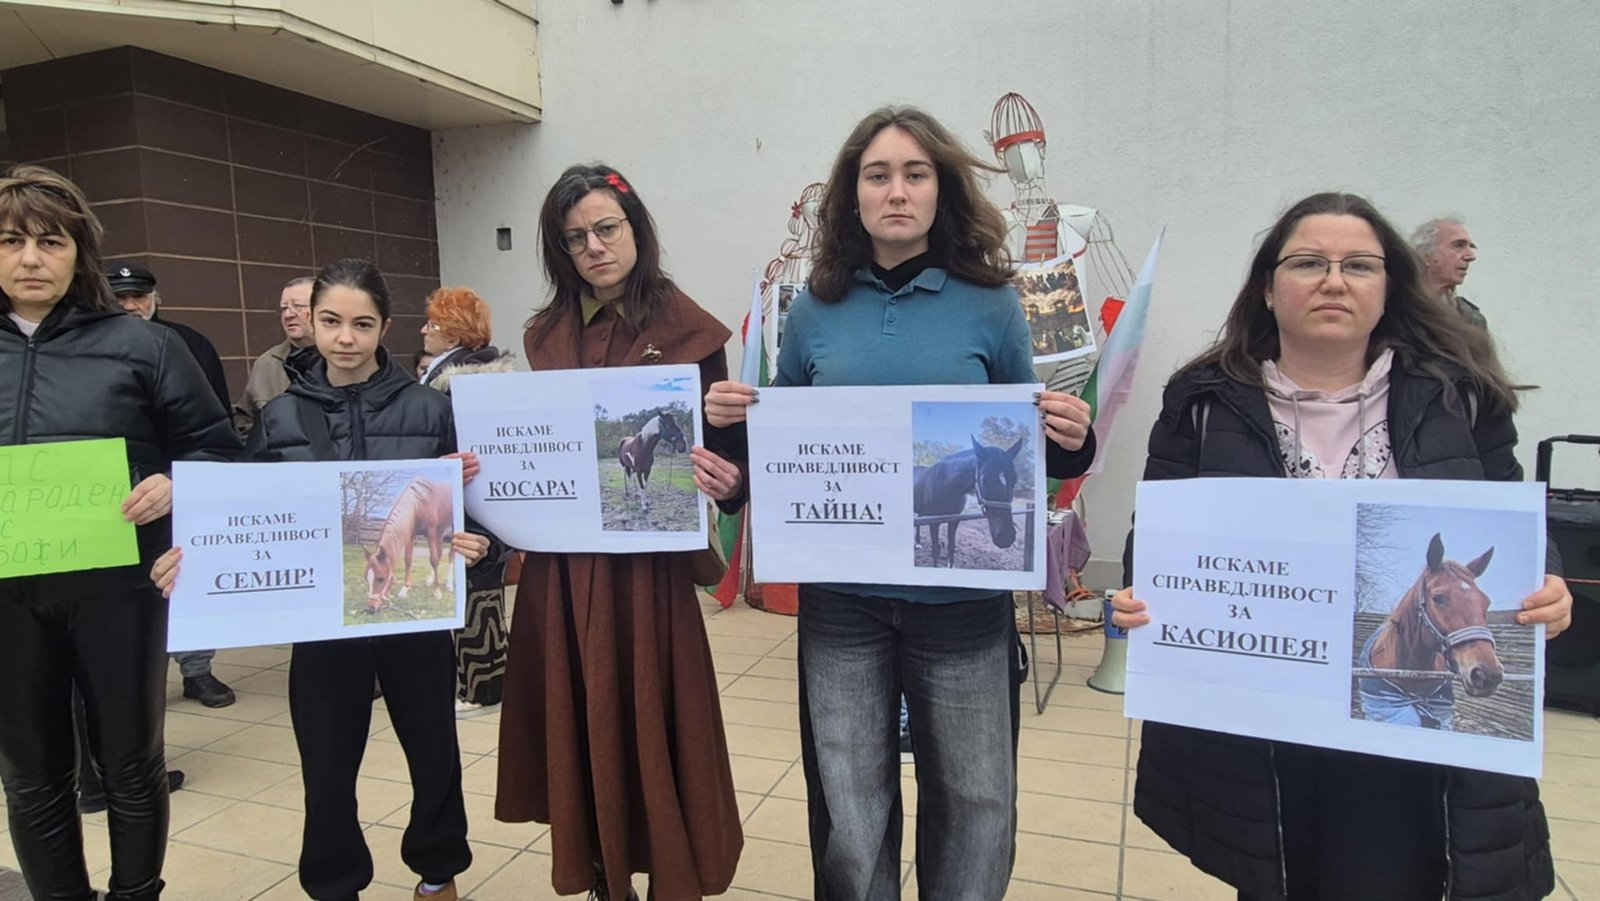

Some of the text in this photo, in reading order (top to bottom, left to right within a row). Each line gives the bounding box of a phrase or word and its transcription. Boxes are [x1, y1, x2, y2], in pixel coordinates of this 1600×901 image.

[496, 424, 555, 438] ИСКАМЕ
[470, 441, 583, 455] СПРАВЕДЛИВОСТ
[798, 443, 865, 456] ИСКАМЕ
[520, 459, 535, 471] ЗА
[765, 461, 900, 475] СПРАВЕДЛИВОСТ
[488, 479, 576, 497] КОСАРА!
[823, 480, 842, 493] ЗА
[791, 498, 882, 520] ТАЙНА!
[228, 512, 297, 527] ИСКАМЕ
[190, 527, 331, 546] СПРАВЕДЛИВОСТ
[252, 549, 271, 561] ЗА
[1196, 554, 1290, 576] ИСКАМЕ
[213, 568, 315, 590] СЕМИР!
[1152, 573, 1338, 604] СПРАВЕДЛИВОСТ
[1227, 603, 1252, 620] ЗА
[1160, 623, 1329, 660] КАСИОПЕЯ!
